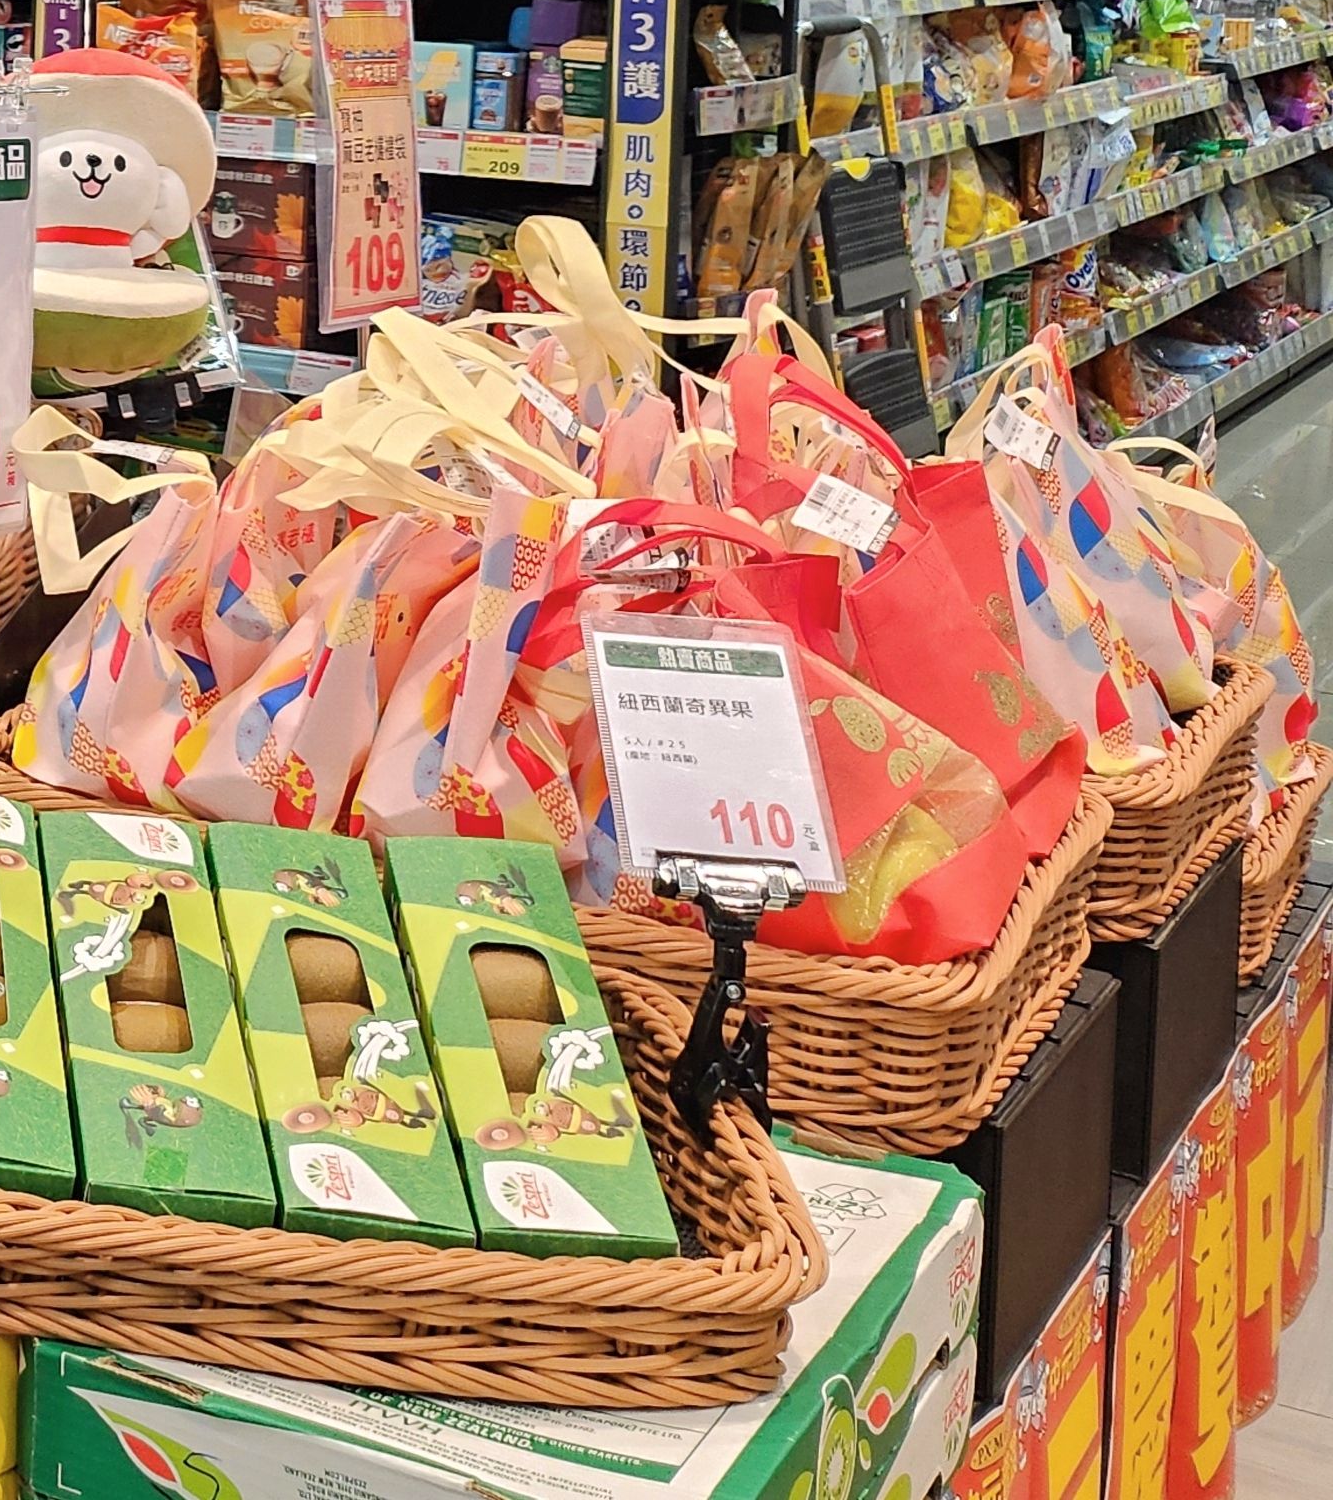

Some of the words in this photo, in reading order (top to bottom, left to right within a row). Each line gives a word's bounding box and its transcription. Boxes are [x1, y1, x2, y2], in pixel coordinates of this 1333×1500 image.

[488, 160, 521, 176] 209
[345, 231, 406, 296] 109
[657, 645, 734, 673] 熱賣商品
[617, 692, 754, 720] 紐西蘭奇異果
[710, 798, 796, 850] 110
[321, 1153, 352, 1201] Zespri
[517, 1171, 550, 1220] Zespri
[398, 1398, 444, 1424] NEW
[443, 1412, 535, 1451] ZEALAND.
